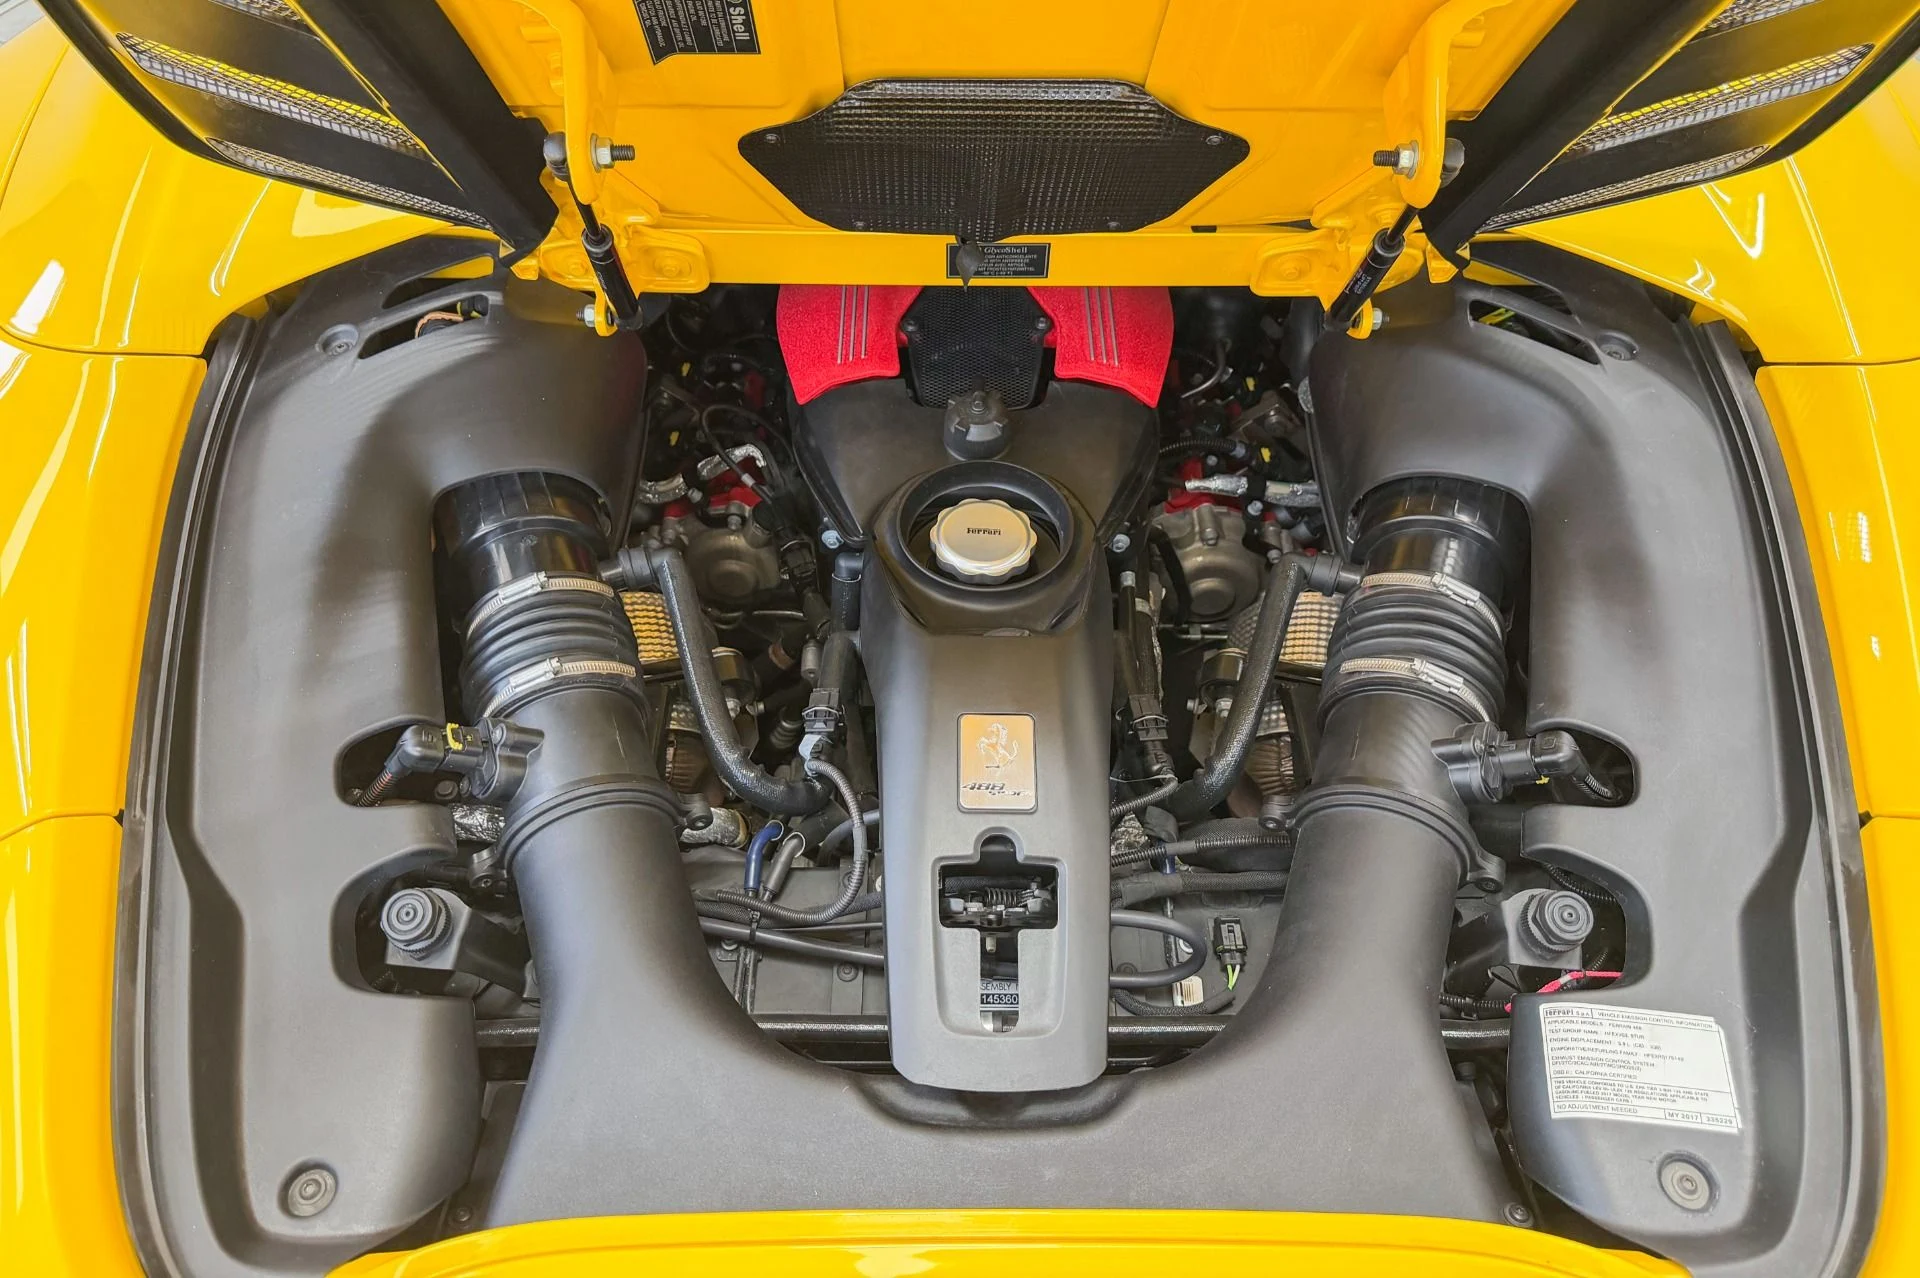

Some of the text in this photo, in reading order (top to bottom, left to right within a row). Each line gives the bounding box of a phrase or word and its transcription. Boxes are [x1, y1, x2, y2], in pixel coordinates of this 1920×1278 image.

[730, 6, 750, 40] Shell
[966, 528, 1001, 536] Ferrari
[962, 782, 1006, 790] 488
